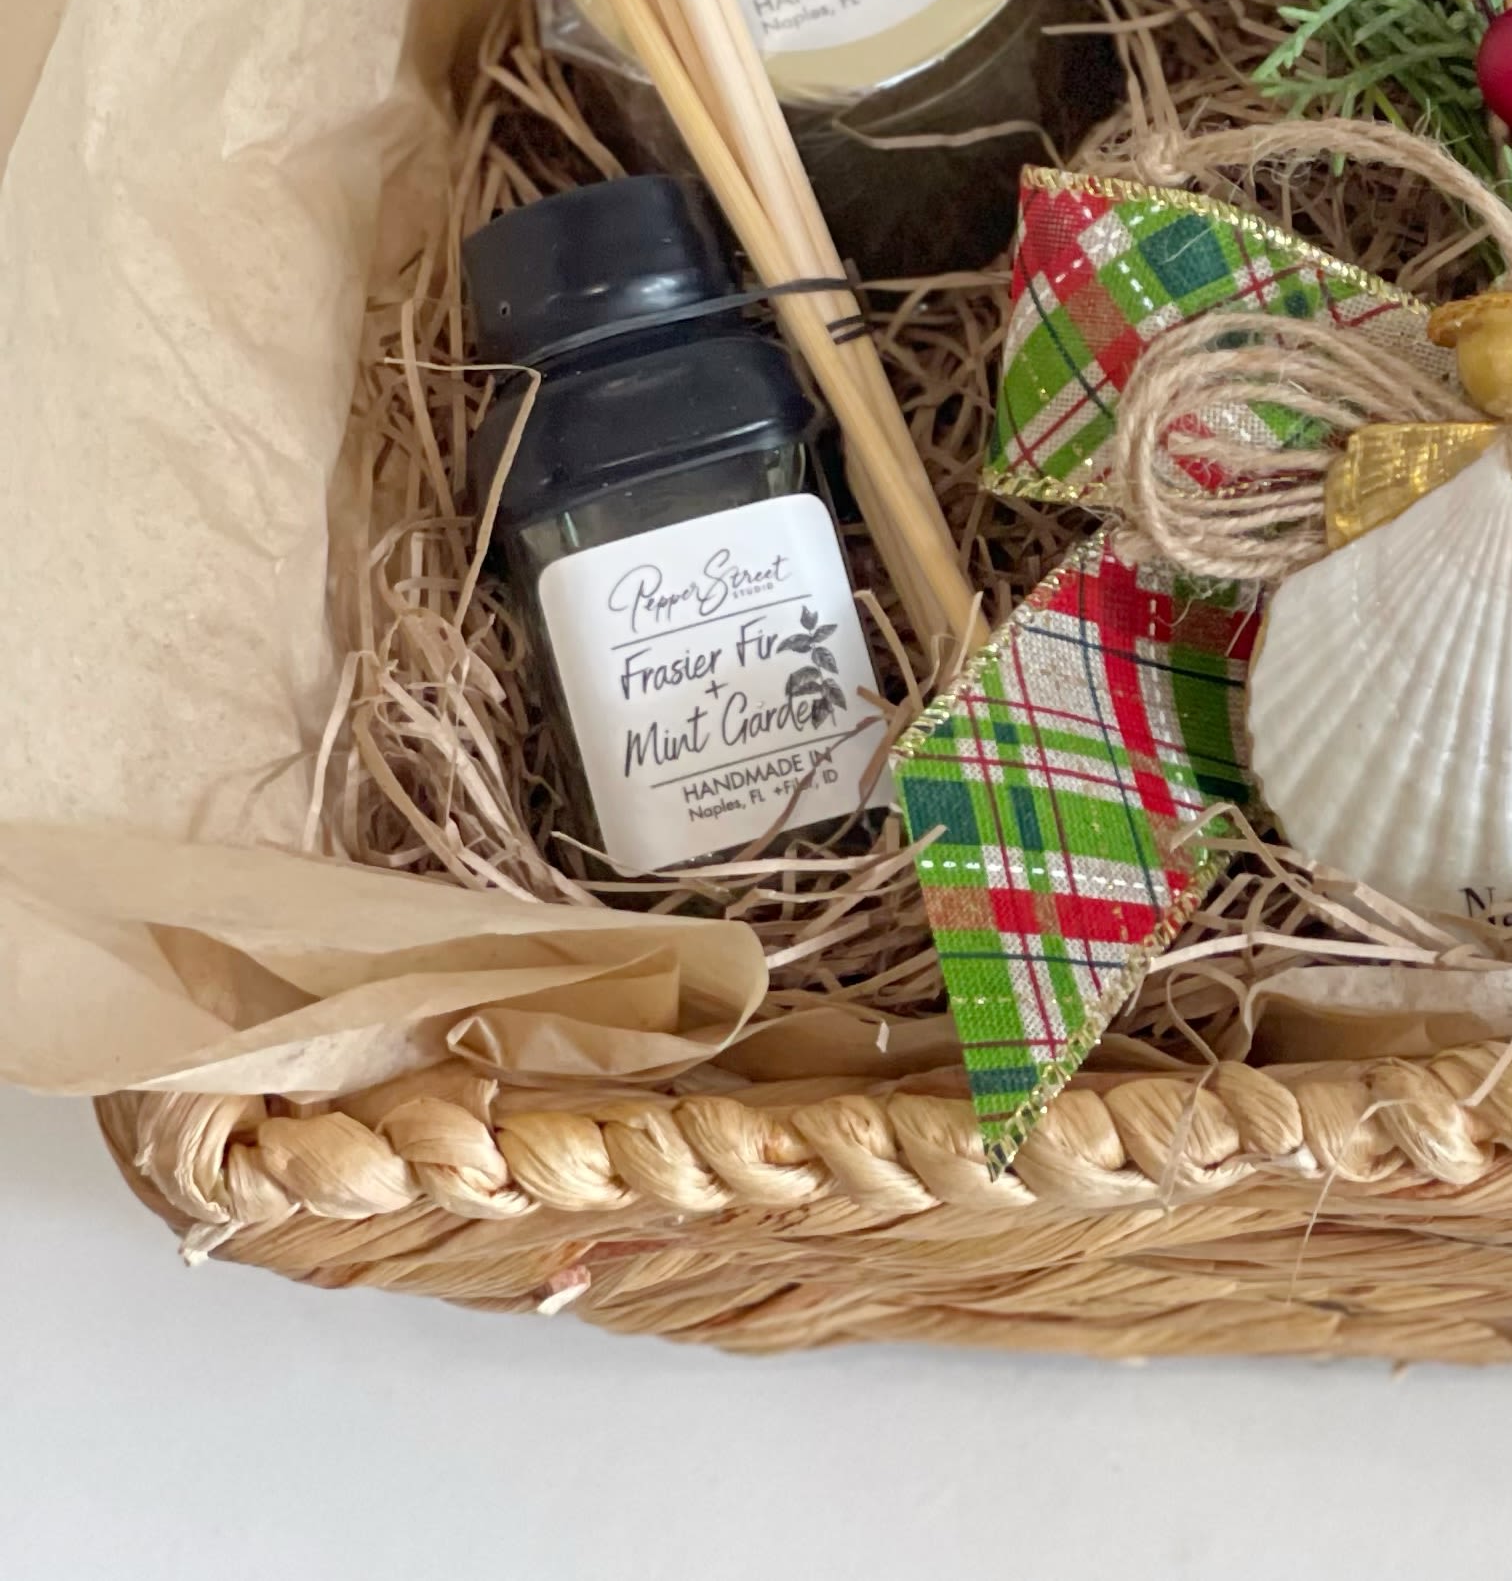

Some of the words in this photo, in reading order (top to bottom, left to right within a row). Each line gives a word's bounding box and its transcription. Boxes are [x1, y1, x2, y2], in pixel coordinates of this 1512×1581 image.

[761, 4, 836, 35] Naples,
[732, 581, 775, 600] STUDIO
[621, 647, 722, 701] Frasier
[736, 615, 779, 668] Fir
[623, 705, 711, 779] Mint
[682, 753, 805, 804] HANDMADE
[809, 746, 834, 768] IN
[688, 797, 747, 823] Naples,
[749, 788, 766, 805] FL
[822, 768, 839, 785] ID
